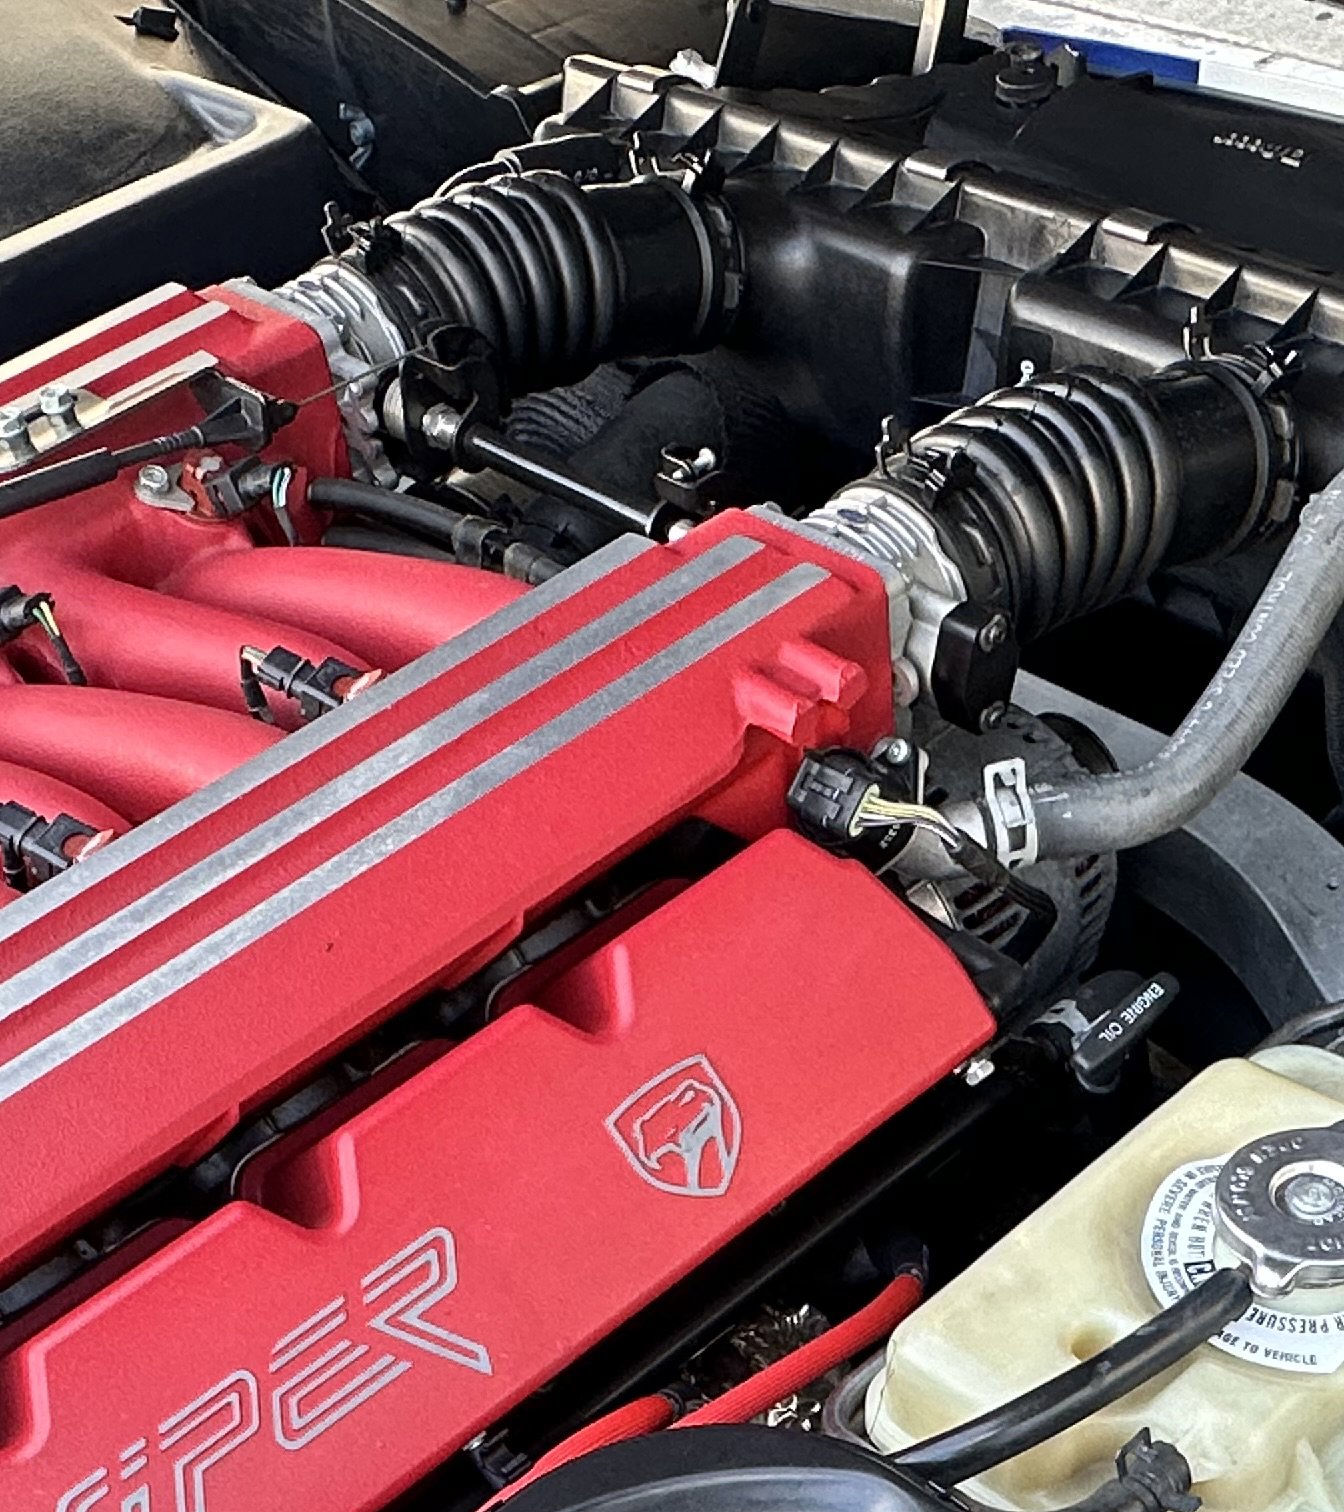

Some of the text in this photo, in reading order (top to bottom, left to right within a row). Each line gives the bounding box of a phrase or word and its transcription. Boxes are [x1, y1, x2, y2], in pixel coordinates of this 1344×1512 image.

[1098, 982, 1165, 1042] ENGINE OIL
[1245, 1306, 1330, 1334] PRESSURE
